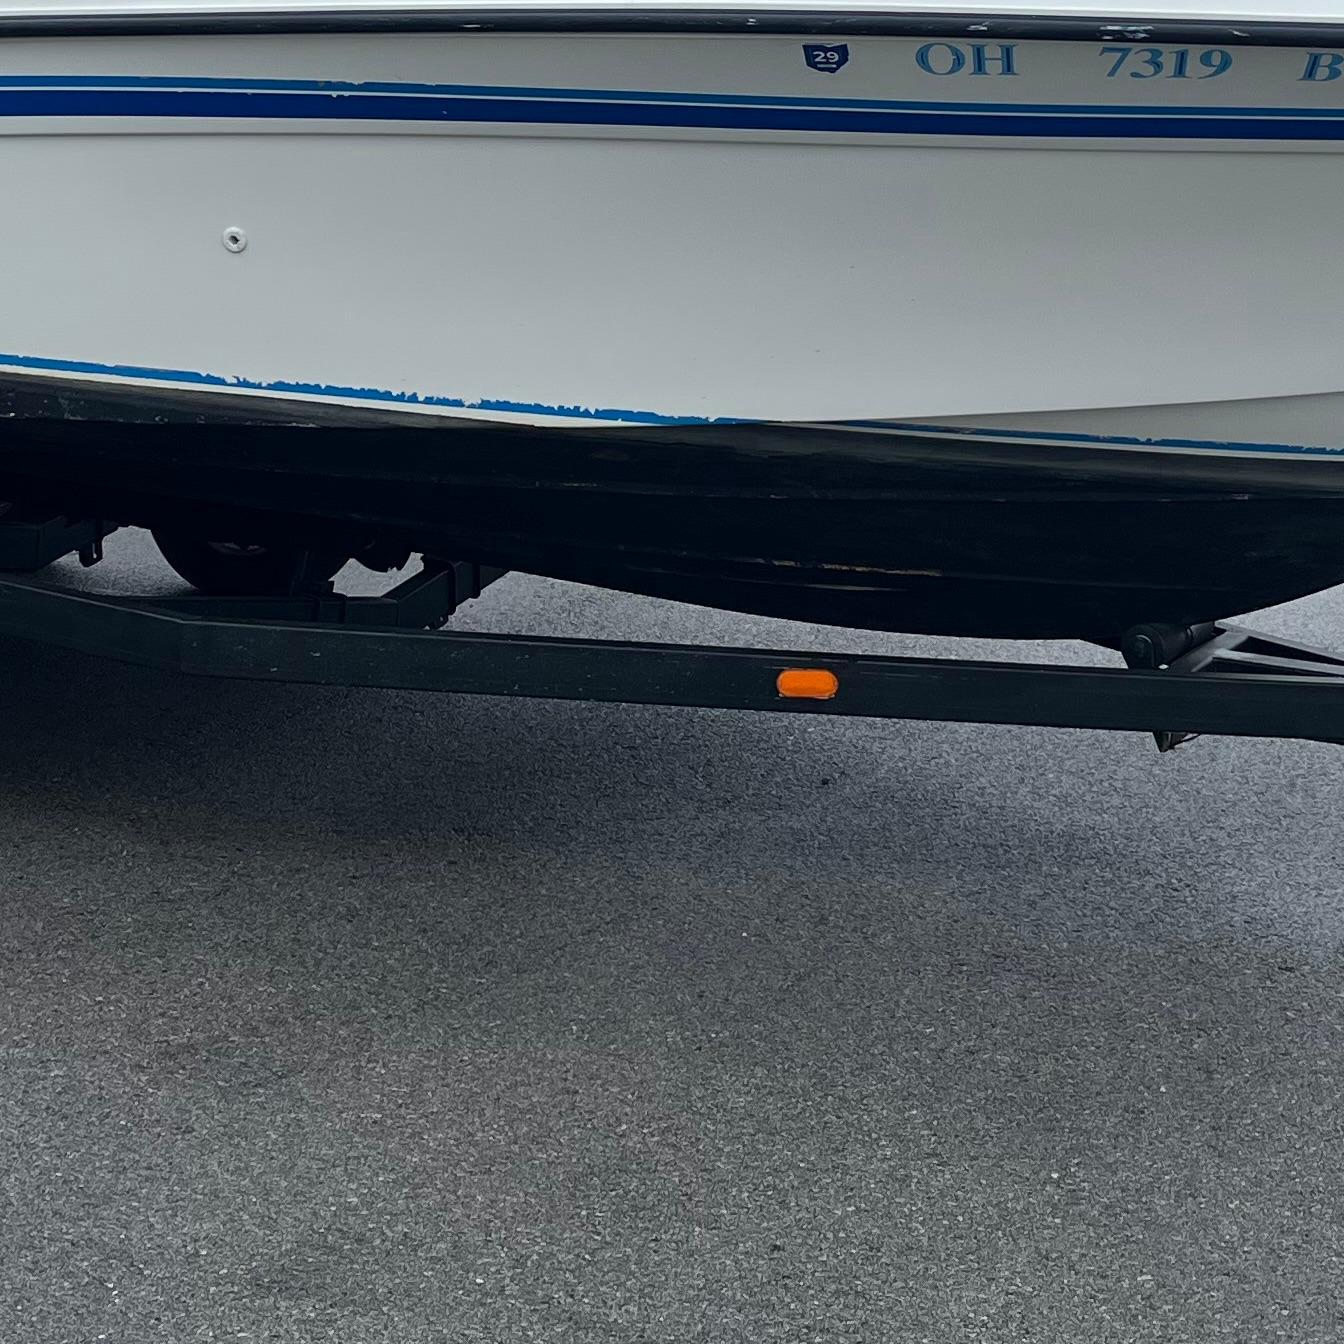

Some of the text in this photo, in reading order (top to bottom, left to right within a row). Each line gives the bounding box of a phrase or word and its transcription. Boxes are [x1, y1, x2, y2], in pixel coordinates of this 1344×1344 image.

[813, 51, 839, 63] 29
[915, 42, 1020, 76] OH
[1098, 46, 1233, 79] 7319
